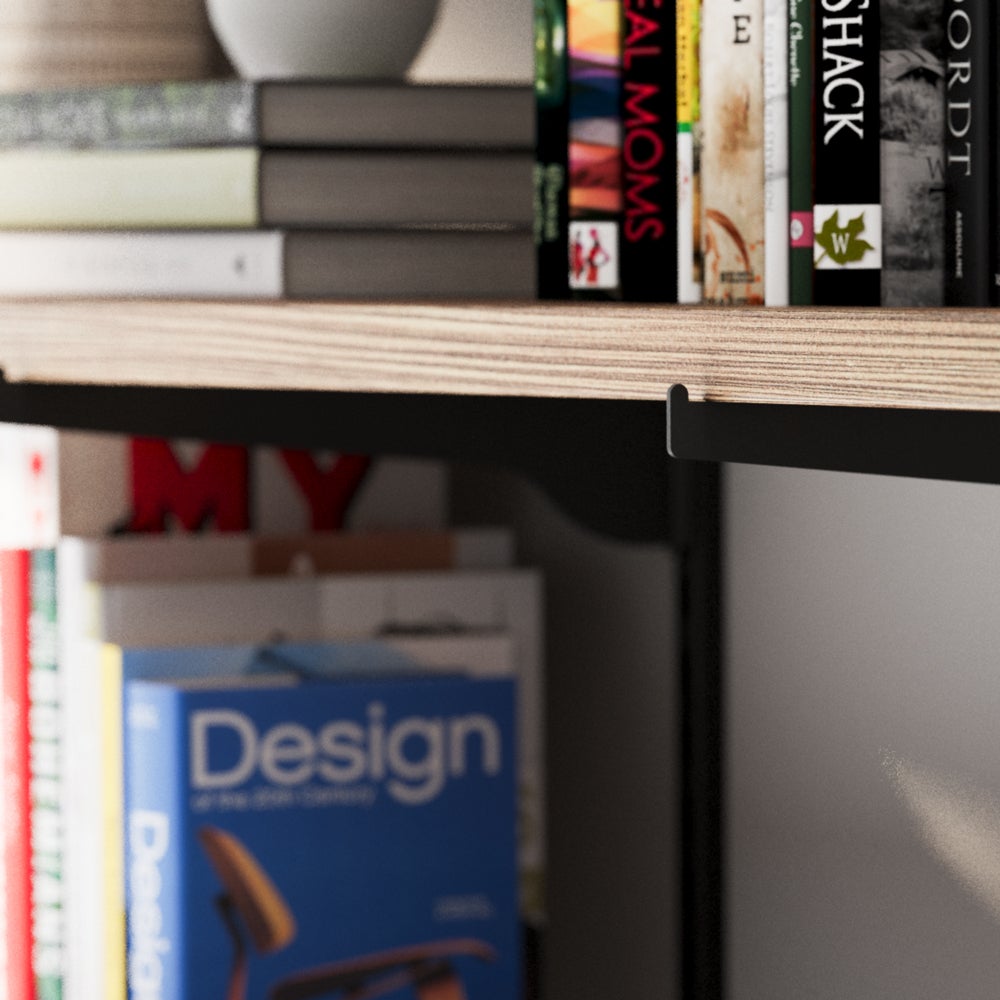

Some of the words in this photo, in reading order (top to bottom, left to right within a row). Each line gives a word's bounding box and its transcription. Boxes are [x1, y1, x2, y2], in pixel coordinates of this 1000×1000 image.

[948, 0, 971, 176] ORDT
[623, 82, 664, 243] MOMS
[955, 210, 963, 278] ASSOULINE
[190, 703, 499, 804] Design
